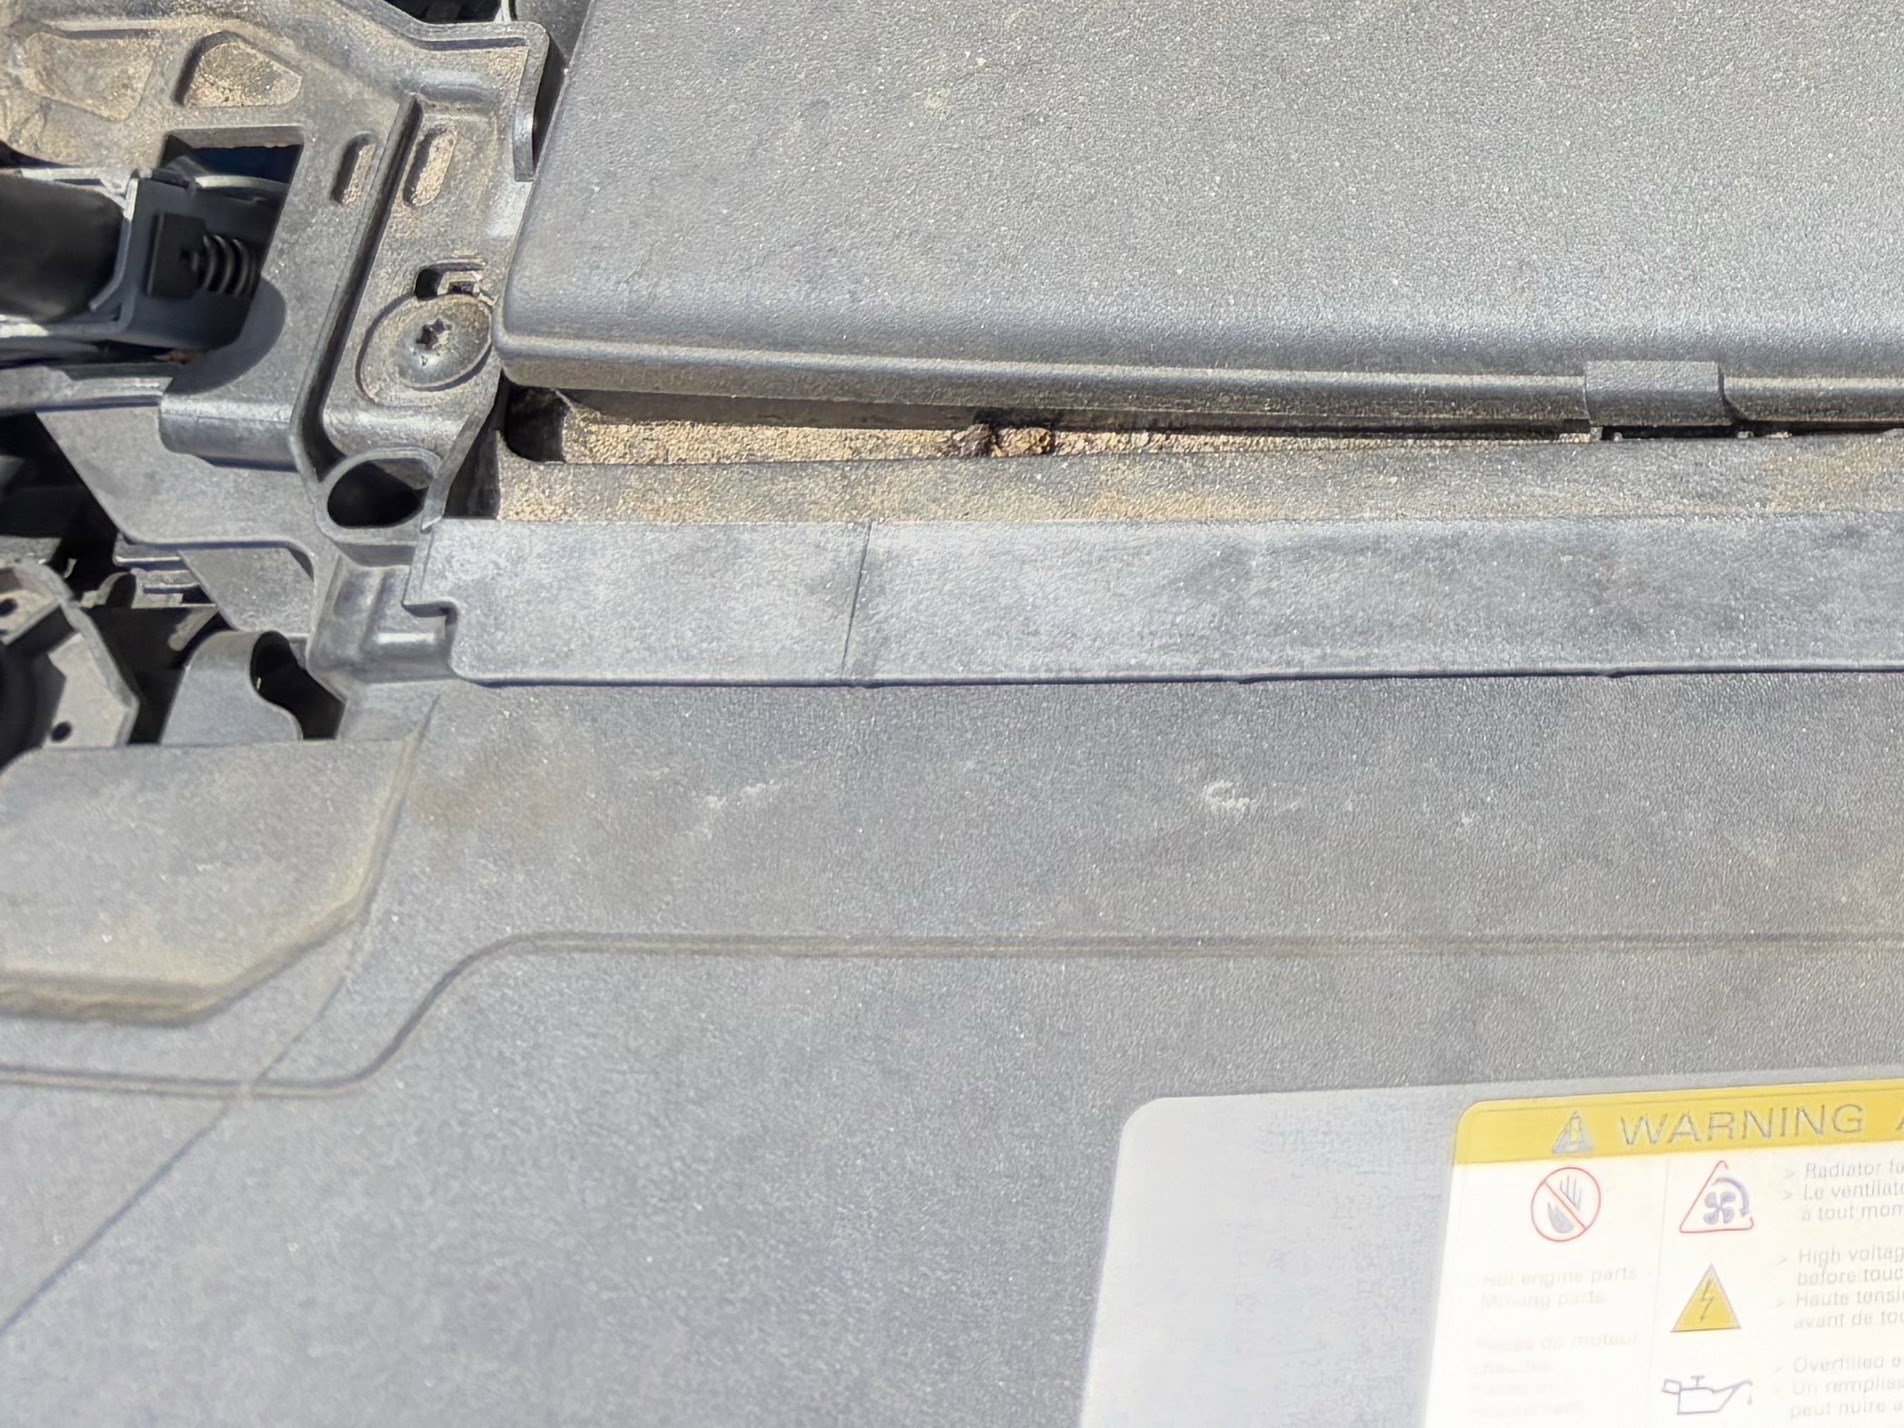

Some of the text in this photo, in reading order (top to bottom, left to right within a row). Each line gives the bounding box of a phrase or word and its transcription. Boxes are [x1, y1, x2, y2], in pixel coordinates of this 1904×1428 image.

[1616, 1102, 1866, 1149] WARNING
[1804, 1162, 1883, 1180] Radiator
[1803, 1183, 1825, 1202] Le
[1817, 1205, 1855, 1222] tout
[1798, 1247, 1842, 1267] High
[1520, 1270, 1584, 1288] engine
[1590, 1266, 1638, 1285] parts
[1796, 1267, 1857, 1287] before
[1796, 1288, 1850, 1307] Haute
[1794, 1311, 1846, 1330] avant
[1851, 1309, 1874, 1328] de
[1792, 1379, 1819, 1397] Un
[1789, 1400, 1832, 1421] peut
[1838, 1395, 1888, 1416] nuire
